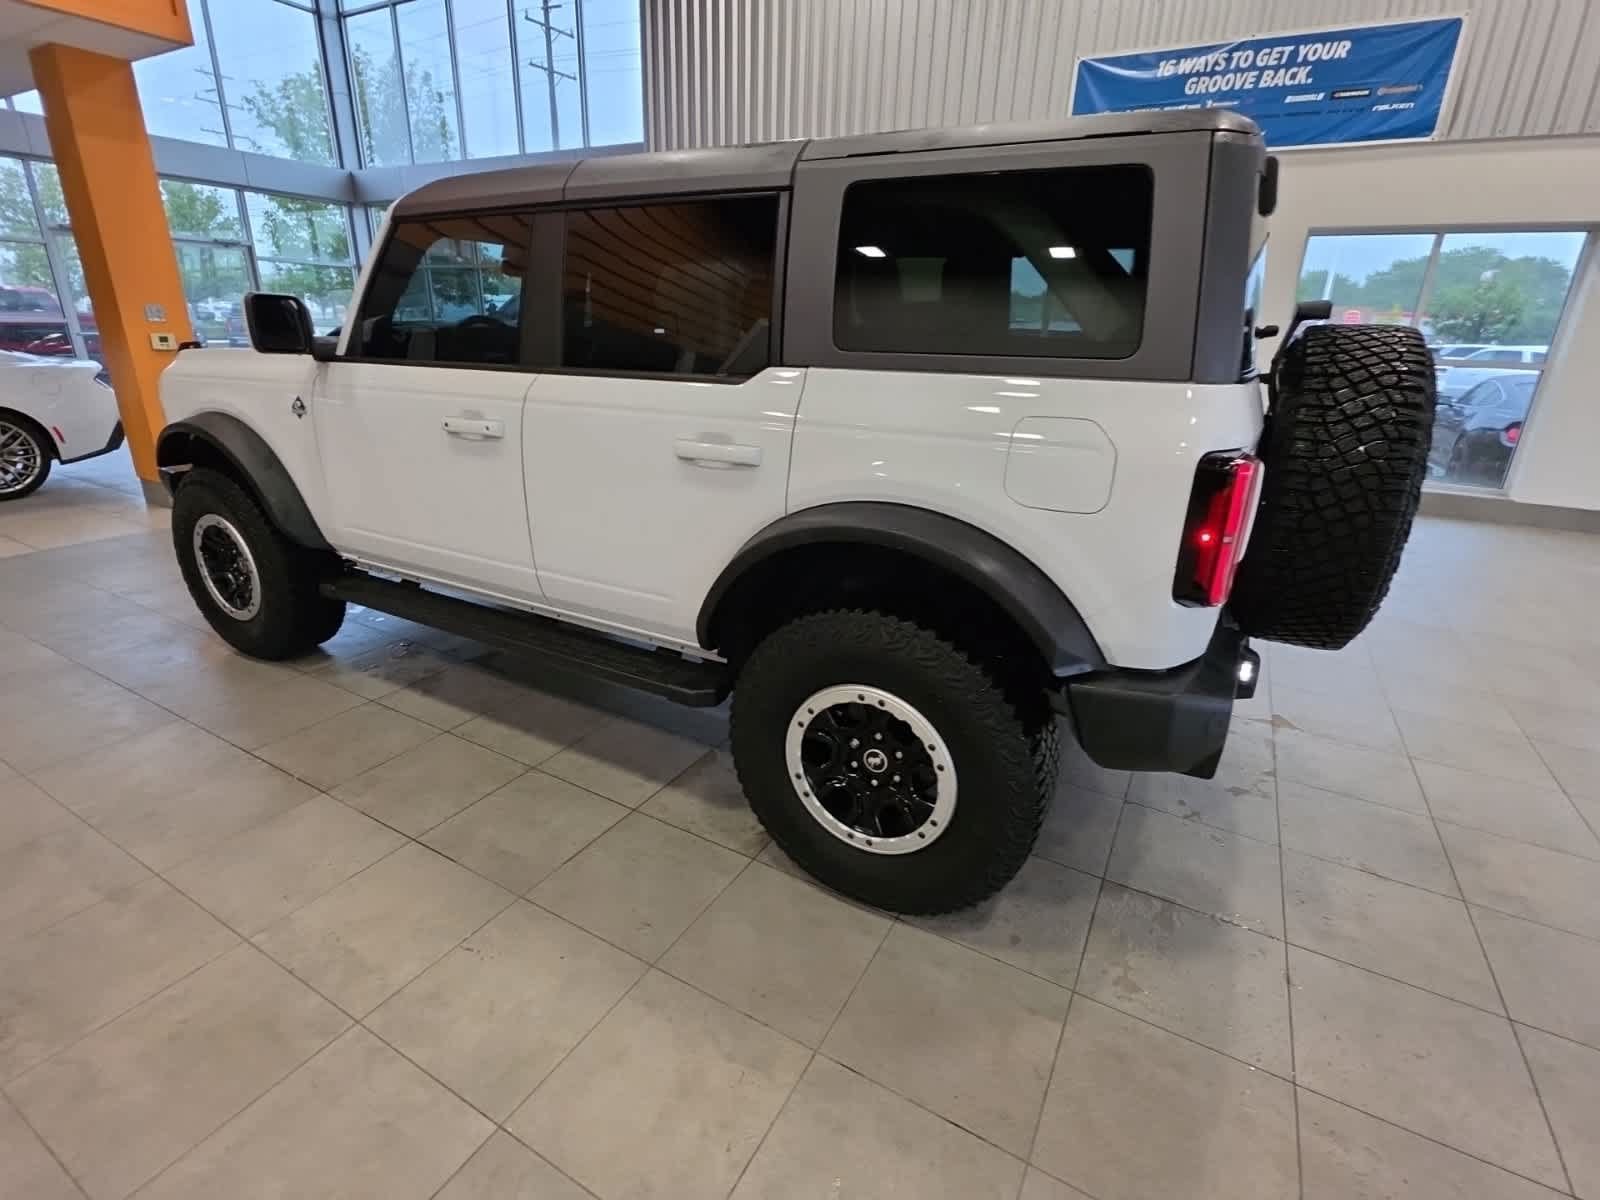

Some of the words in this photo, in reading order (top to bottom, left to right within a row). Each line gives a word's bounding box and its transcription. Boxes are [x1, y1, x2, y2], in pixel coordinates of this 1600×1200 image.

[1157, 60, 1177, 77] 16
[1176, 52, 1227, 75] WAYS
[1231, 50, 1254, 70] TO
[1256, 46, 1294, 67] GET
[1297, 40, 1352, 63] YOUR
[1185, 70, 1259, 95] GROOVE
[1258, 66, 1313, 88] BACK.
